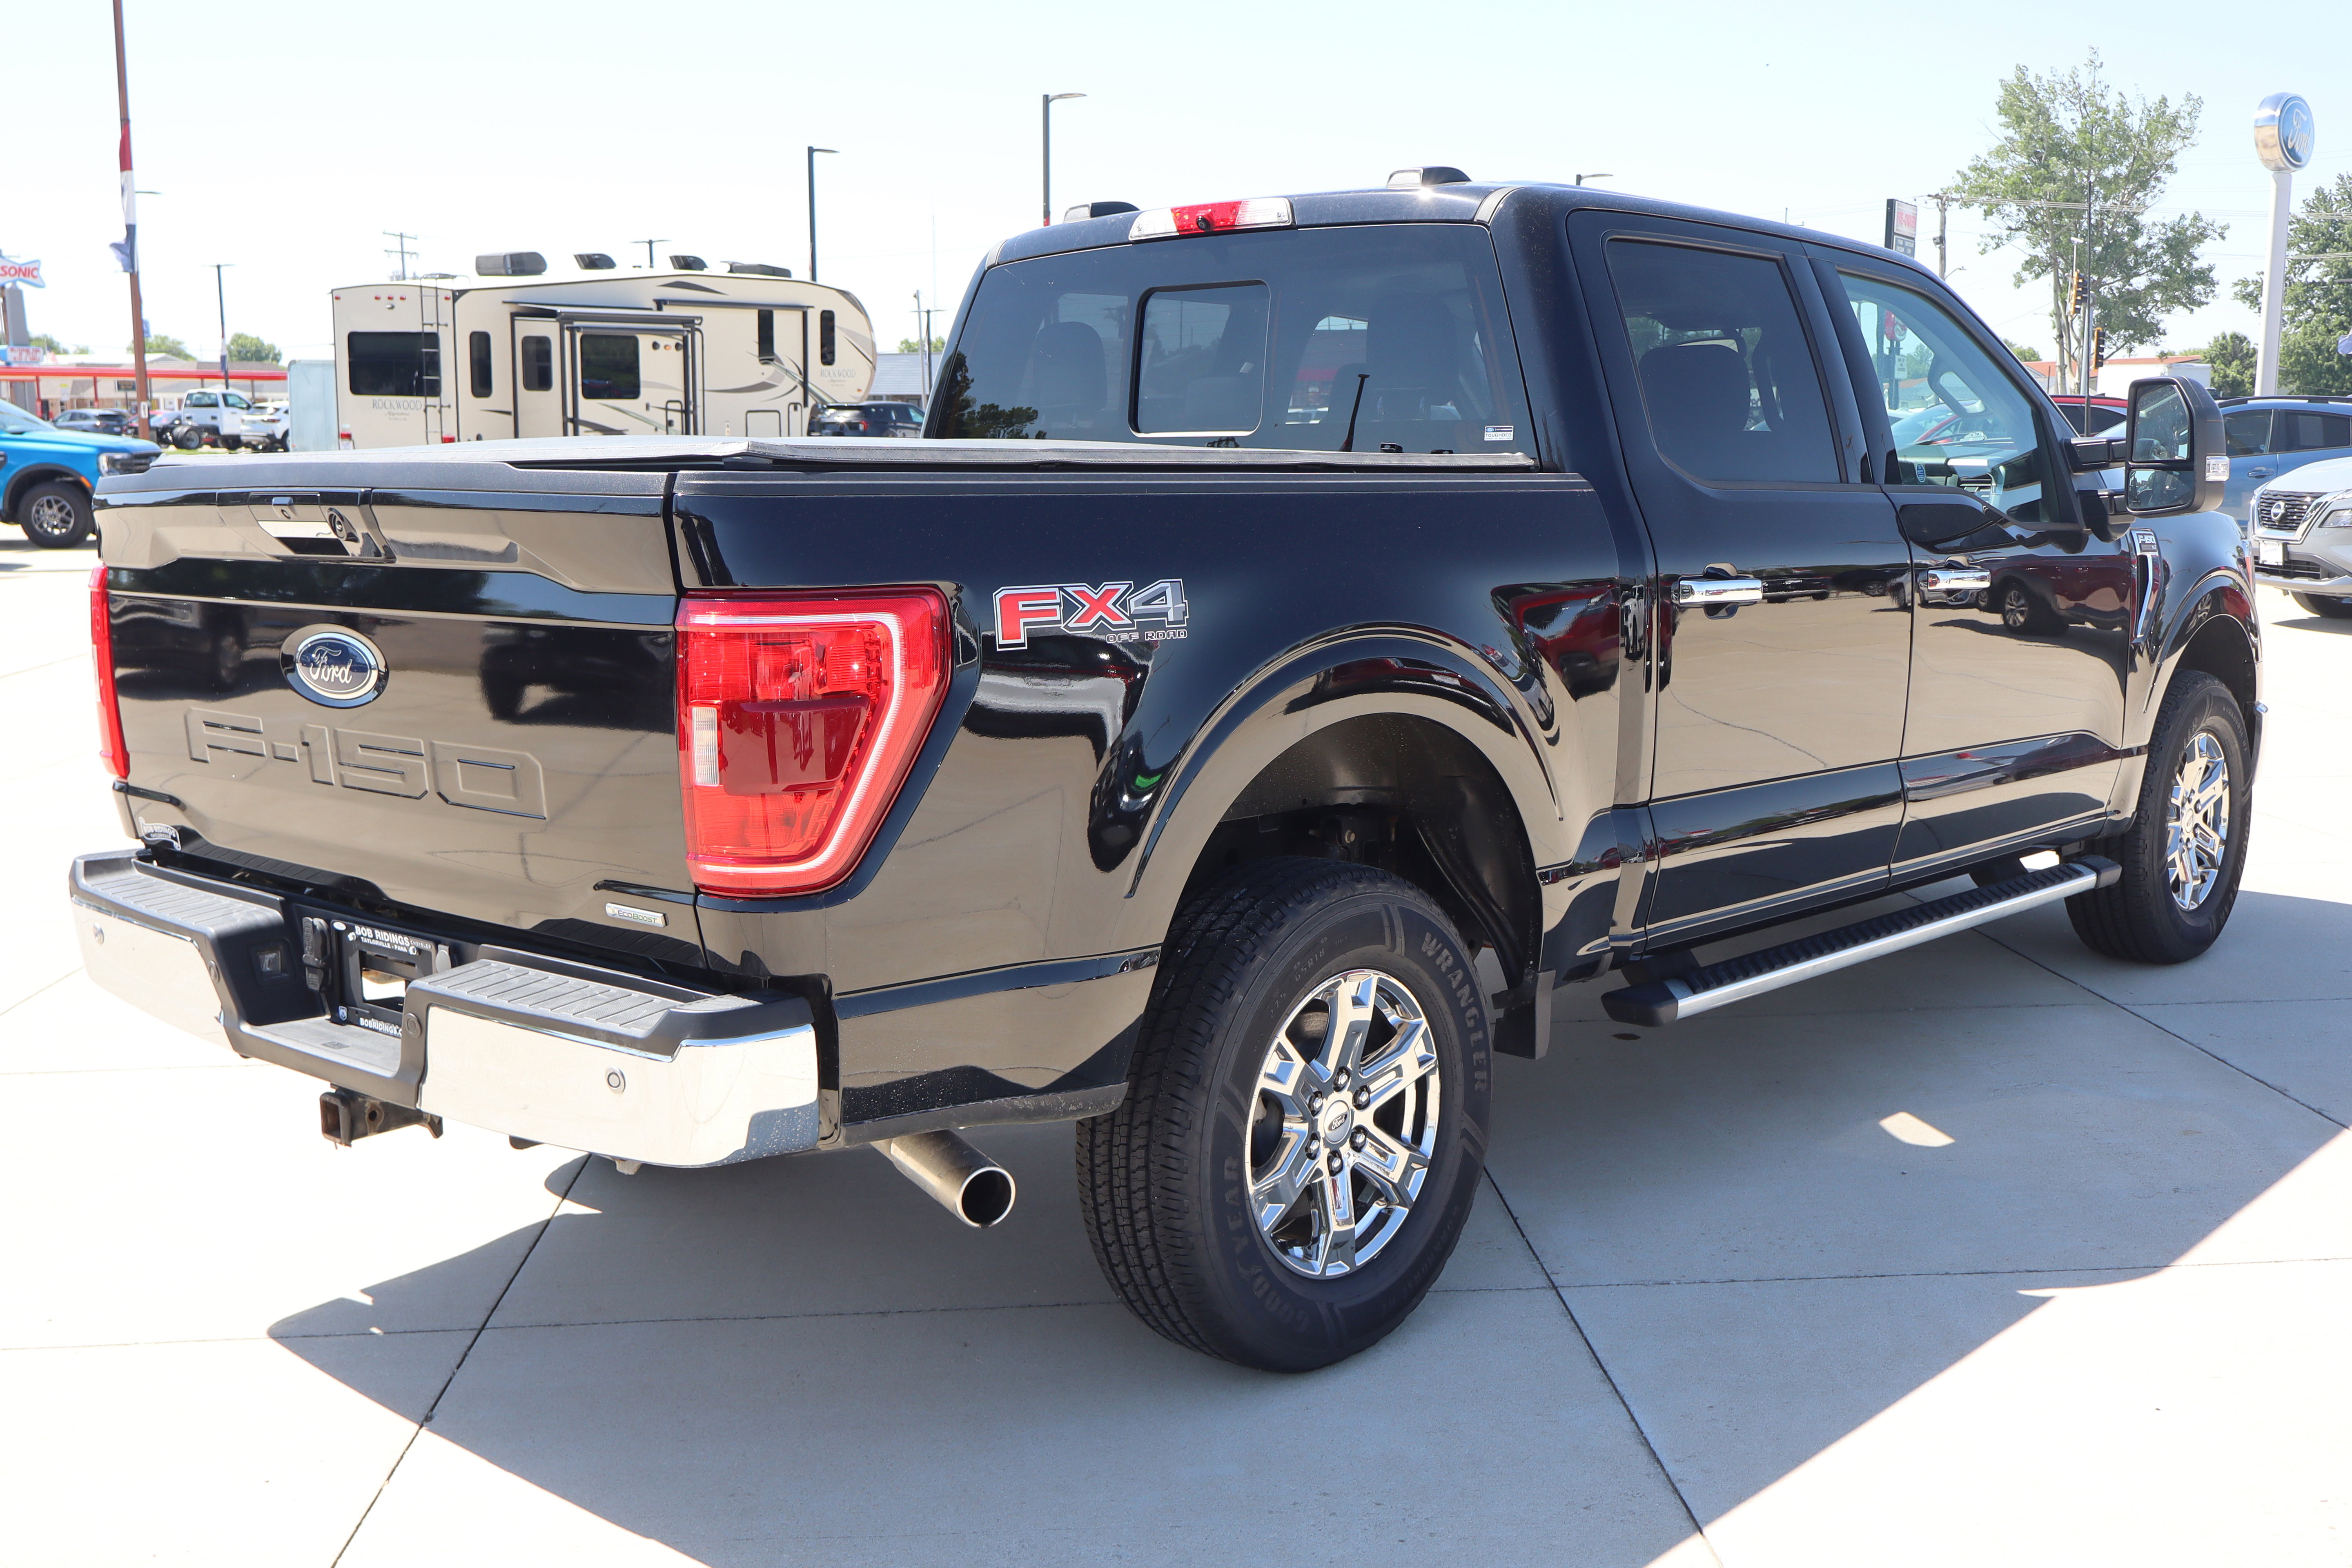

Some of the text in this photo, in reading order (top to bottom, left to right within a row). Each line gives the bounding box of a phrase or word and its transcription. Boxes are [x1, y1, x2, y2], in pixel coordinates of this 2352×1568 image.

[2288, 108, 2311, 154] Ford
[0, 265, 38, 279] SONIC
[820, 369, 856, 378] ROCKWOOD
[372, 399, 422, 410] ROCKWOOD
[2138, 535, 2156, 543] F-150
[993, 579, 1189, 651] FX4
[1106, 629, 1188, 644] OFF ROAD
[310, 646, 352, 684] Ford
[184, 707, 546, 820] F-150
[618, 910, 657, 923] ECOBOOST
[354, 925, 373, 938] BOB
[374, 929, 410, 947] RIDINGS
[360, 936, 391, 949] TAYLORVILLE
[1270, 992, 1286, 1019] 275
[1421, 931, 1488, 1092] WRANGLER
[1332, 1114, 1345, 1130] Ford
